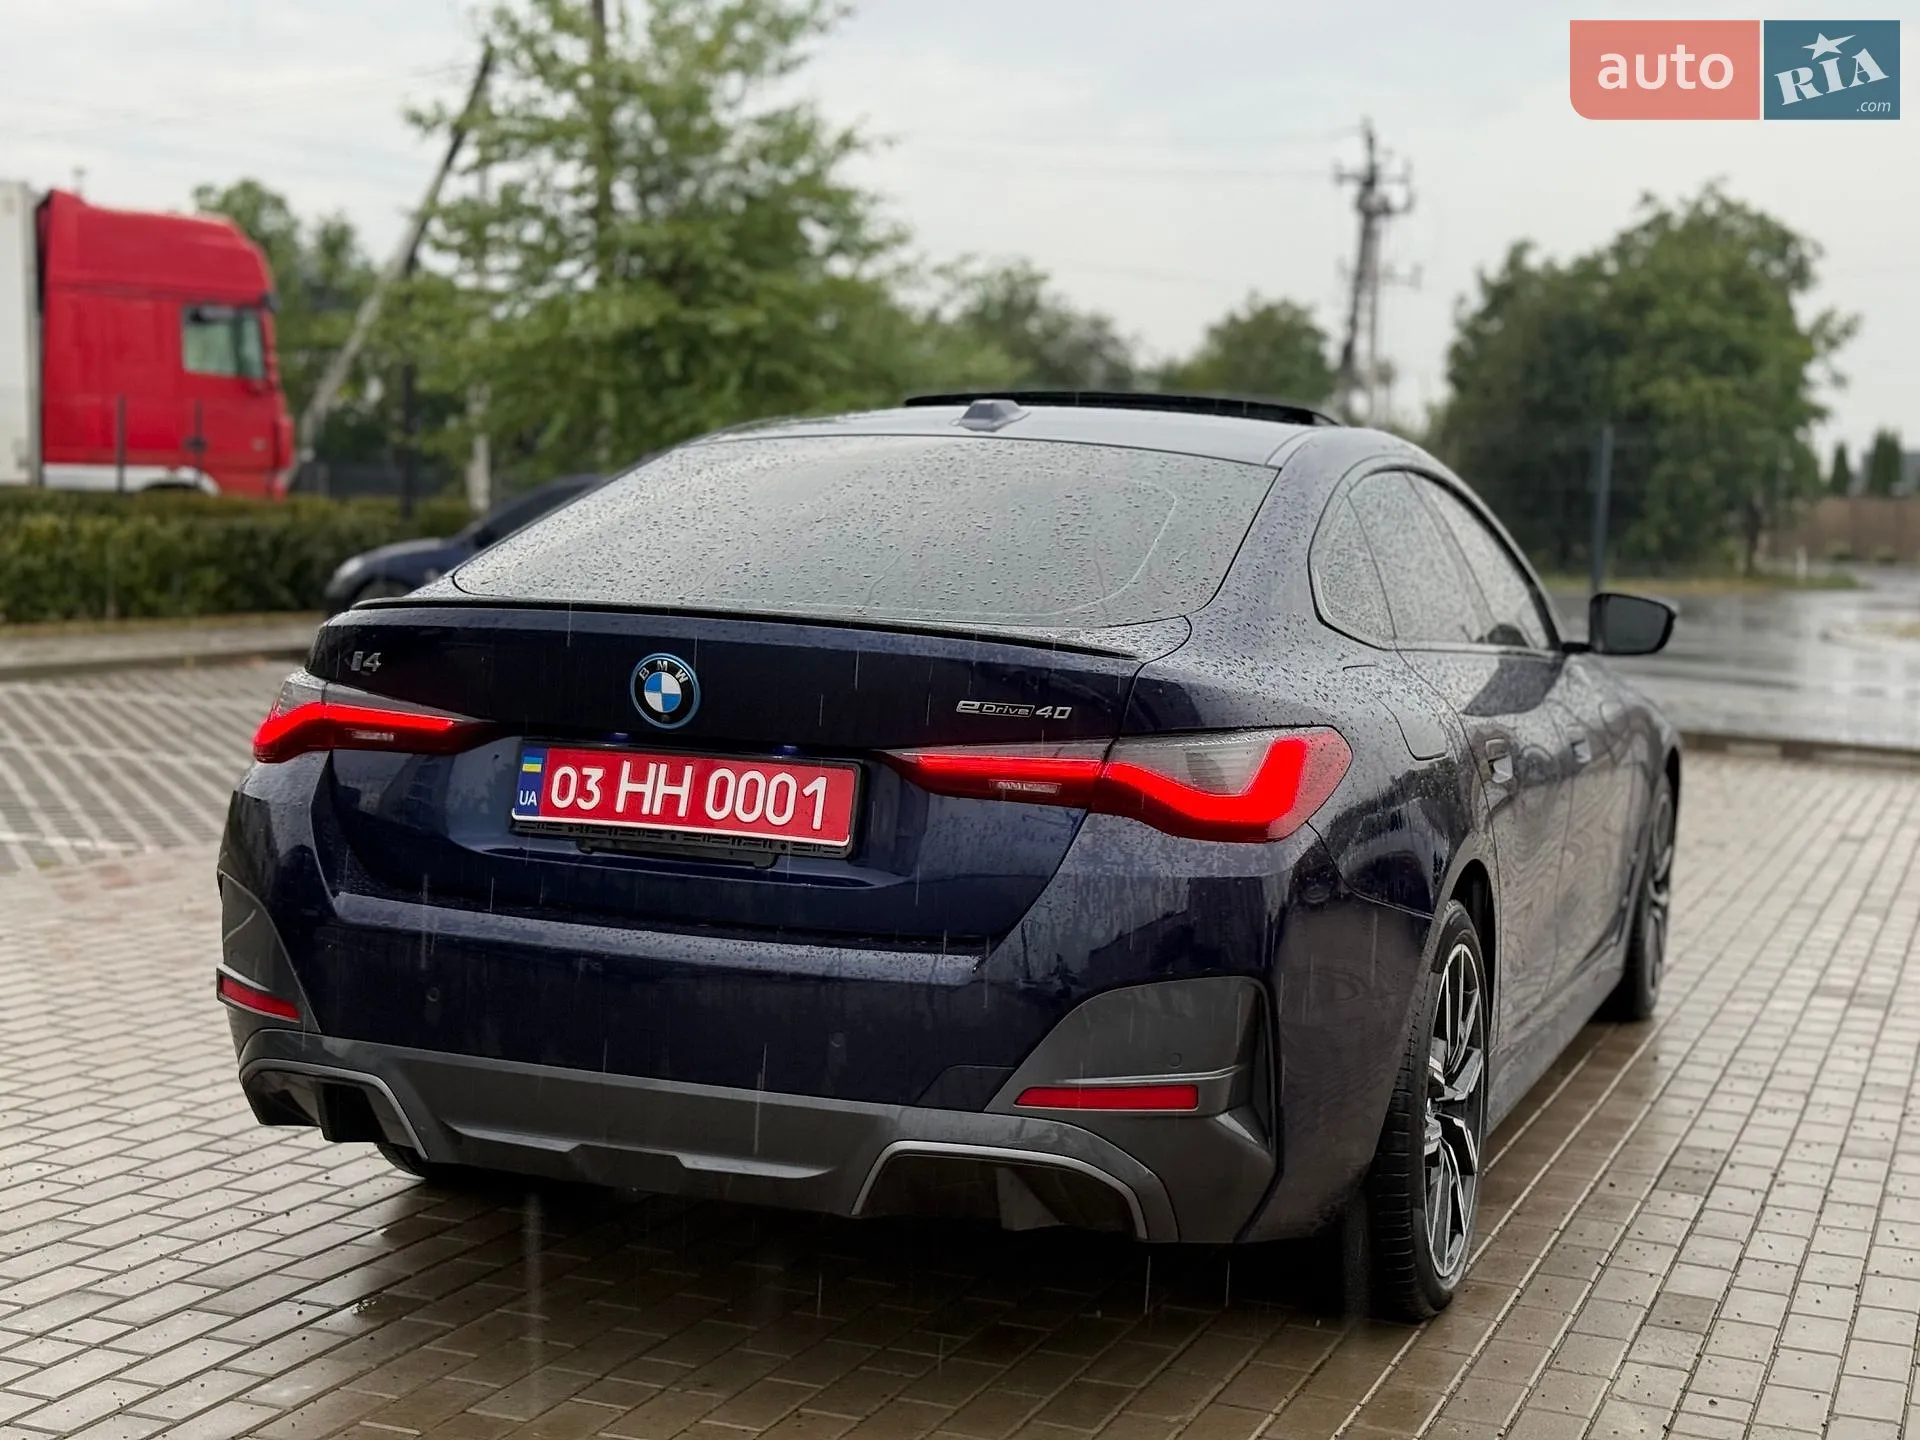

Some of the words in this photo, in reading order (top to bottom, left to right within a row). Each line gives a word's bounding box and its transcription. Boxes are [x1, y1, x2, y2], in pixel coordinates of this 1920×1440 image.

[639, 660, 689, 684] BMW
[519, 790, 537, 807] UA
[551, 766, 604, 810] 03
[615, 761, 693, 817] HH
[705, 768, 827, 830] 0001
